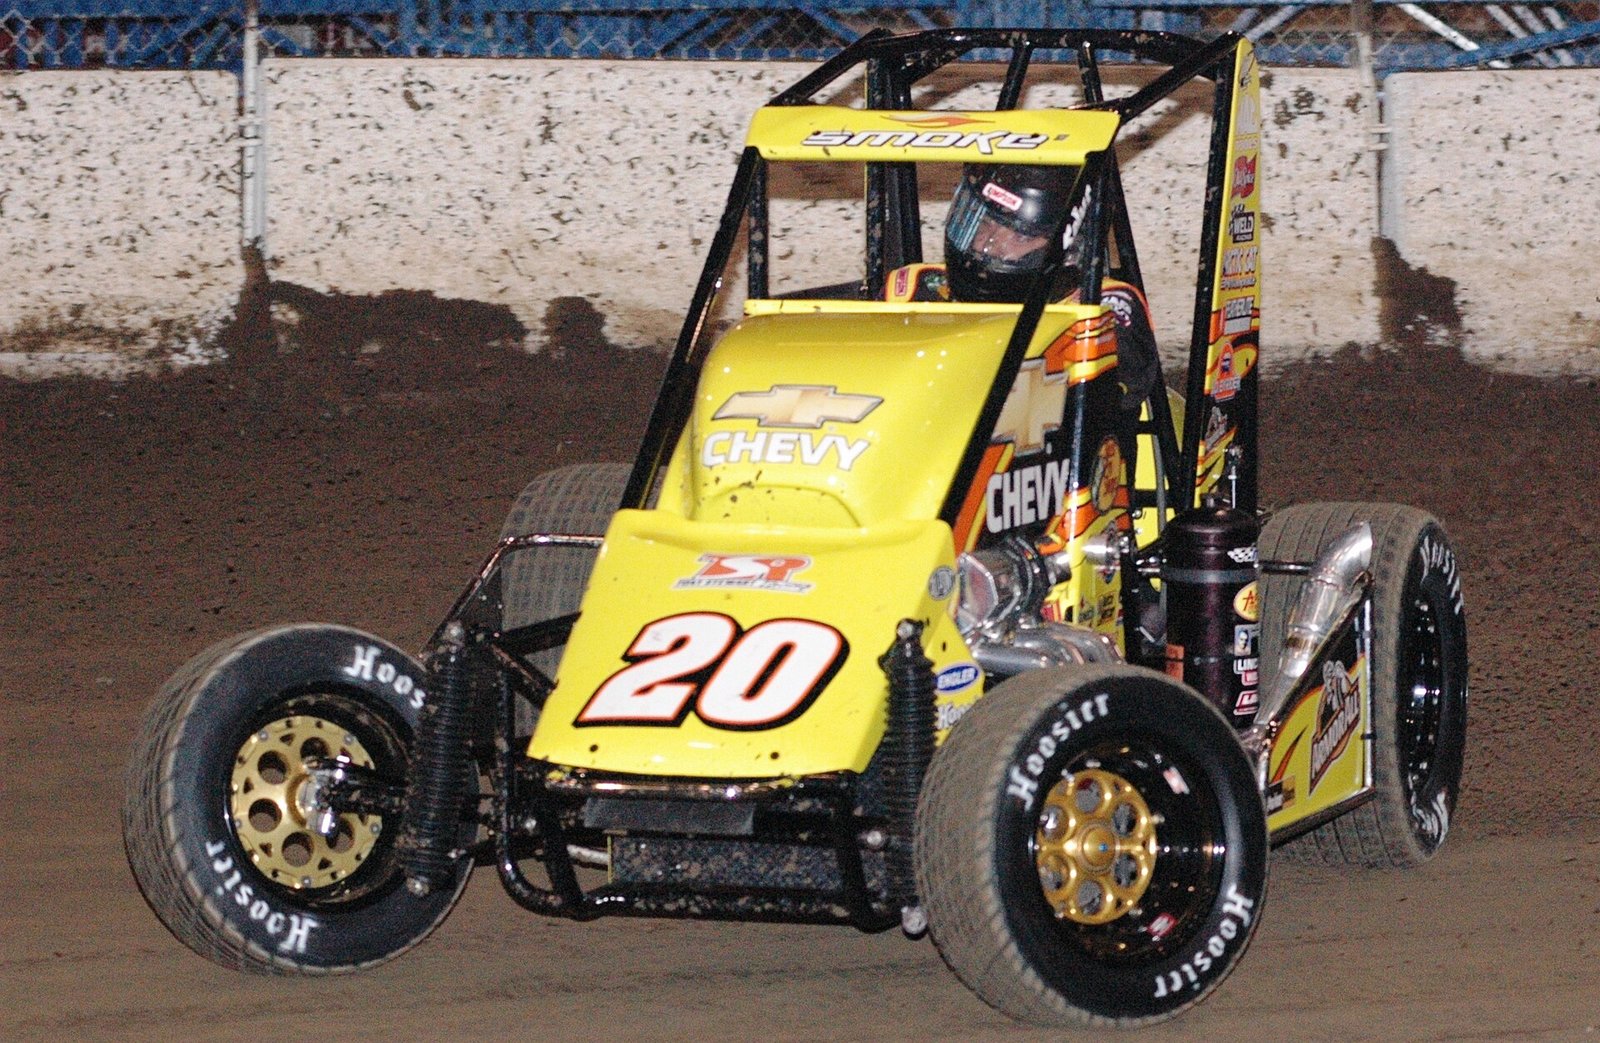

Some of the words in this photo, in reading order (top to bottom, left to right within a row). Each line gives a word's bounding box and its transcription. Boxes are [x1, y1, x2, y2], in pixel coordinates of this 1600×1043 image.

[702, 430, 872, 472] CHEVY
[986, 458, 1070, 534] CHEVY
[343, 645, 427, 710] Hoos
[571, 611, 850, 732] 20
[1007, 692, 1110, 812] Hoosier
[205, 840, 320, 954] Hoosier
[1154, 882, 1255, 999] Hoosier
